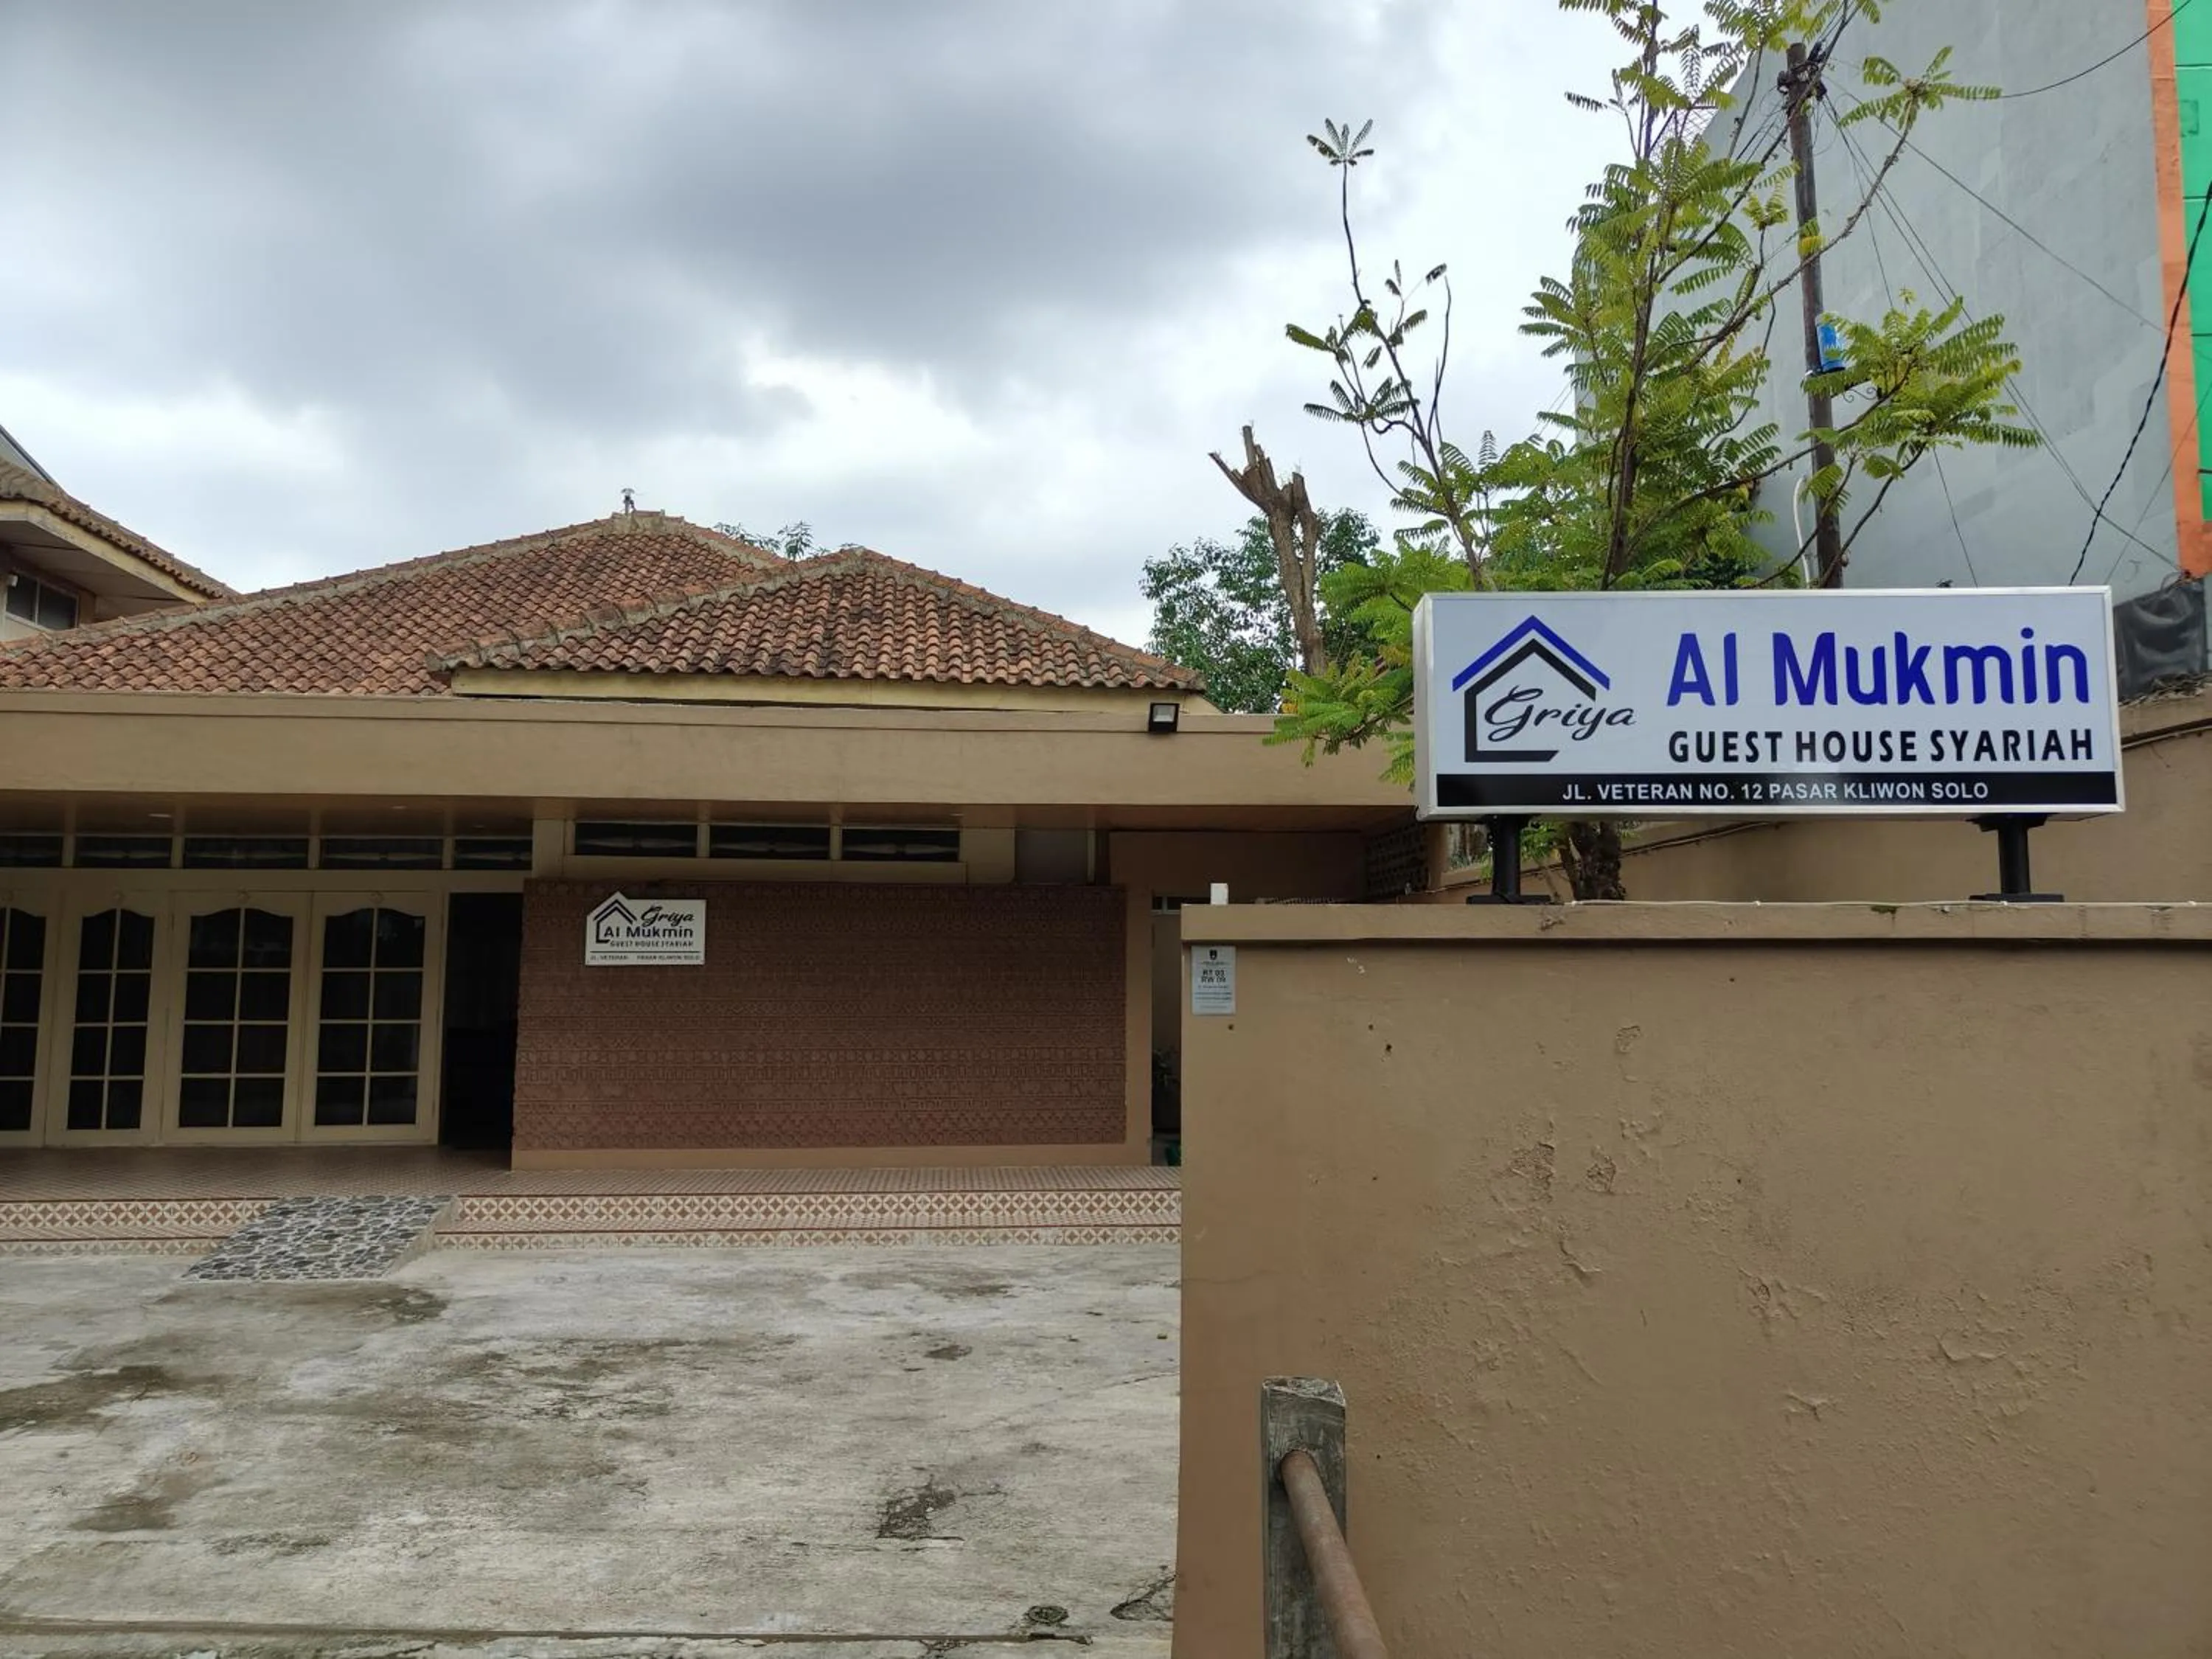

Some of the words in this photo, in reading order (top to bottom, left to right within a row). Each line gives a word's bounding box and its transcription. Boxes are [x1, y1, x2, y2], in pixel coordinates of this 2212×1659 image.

[1666, 632, 1739, 706] Al
[1772, 627, 2090, 706] Mukmin
[1484, 685, 1637, 742] Griya
[1669, 731, 1783, 763] GUEST
[1795, 730, 1918, 763] HOUSE
[1930, 728, 2093, 762] SYARIAH
[1562, 784, 1591, 800] JL.
[1597, 784, 1693, 800] VETERAN
[1700, 783, 1735, 799] NO.
[1741, 783, 1763, 799] 12
[1769, 782, 1838, 799] PASAR
[1843, 782, 1925, 799] KLIWON
[1931, 782, 1989, 799] SOLO
[641, 905, 695, 927] Griya
[604, 926, 620, 938] Al
[627, 926, 694, 938] Mukmin
